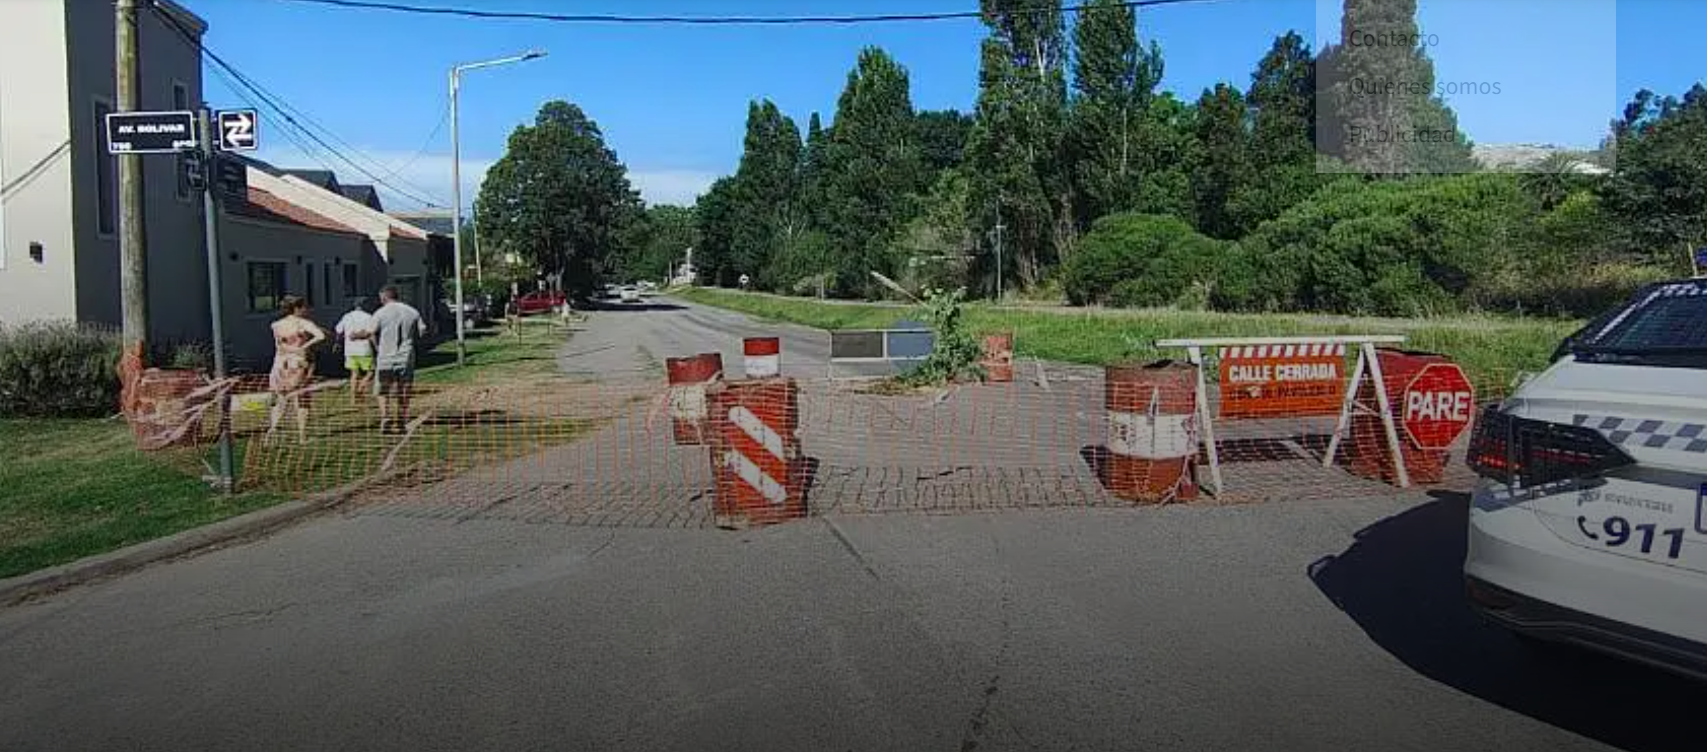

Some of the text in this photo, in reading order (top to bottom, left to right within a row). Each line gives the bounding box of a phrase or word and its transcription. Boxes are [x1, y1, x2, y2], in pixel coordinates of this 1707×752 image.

[118, 124, 186, 133] AV. BOLIVAR
[1229, 363, 1336, 382] CALLE CERRADA
[1407, 391, 1470, 421] PARE
[1603, 516, 1685, 559] 911
